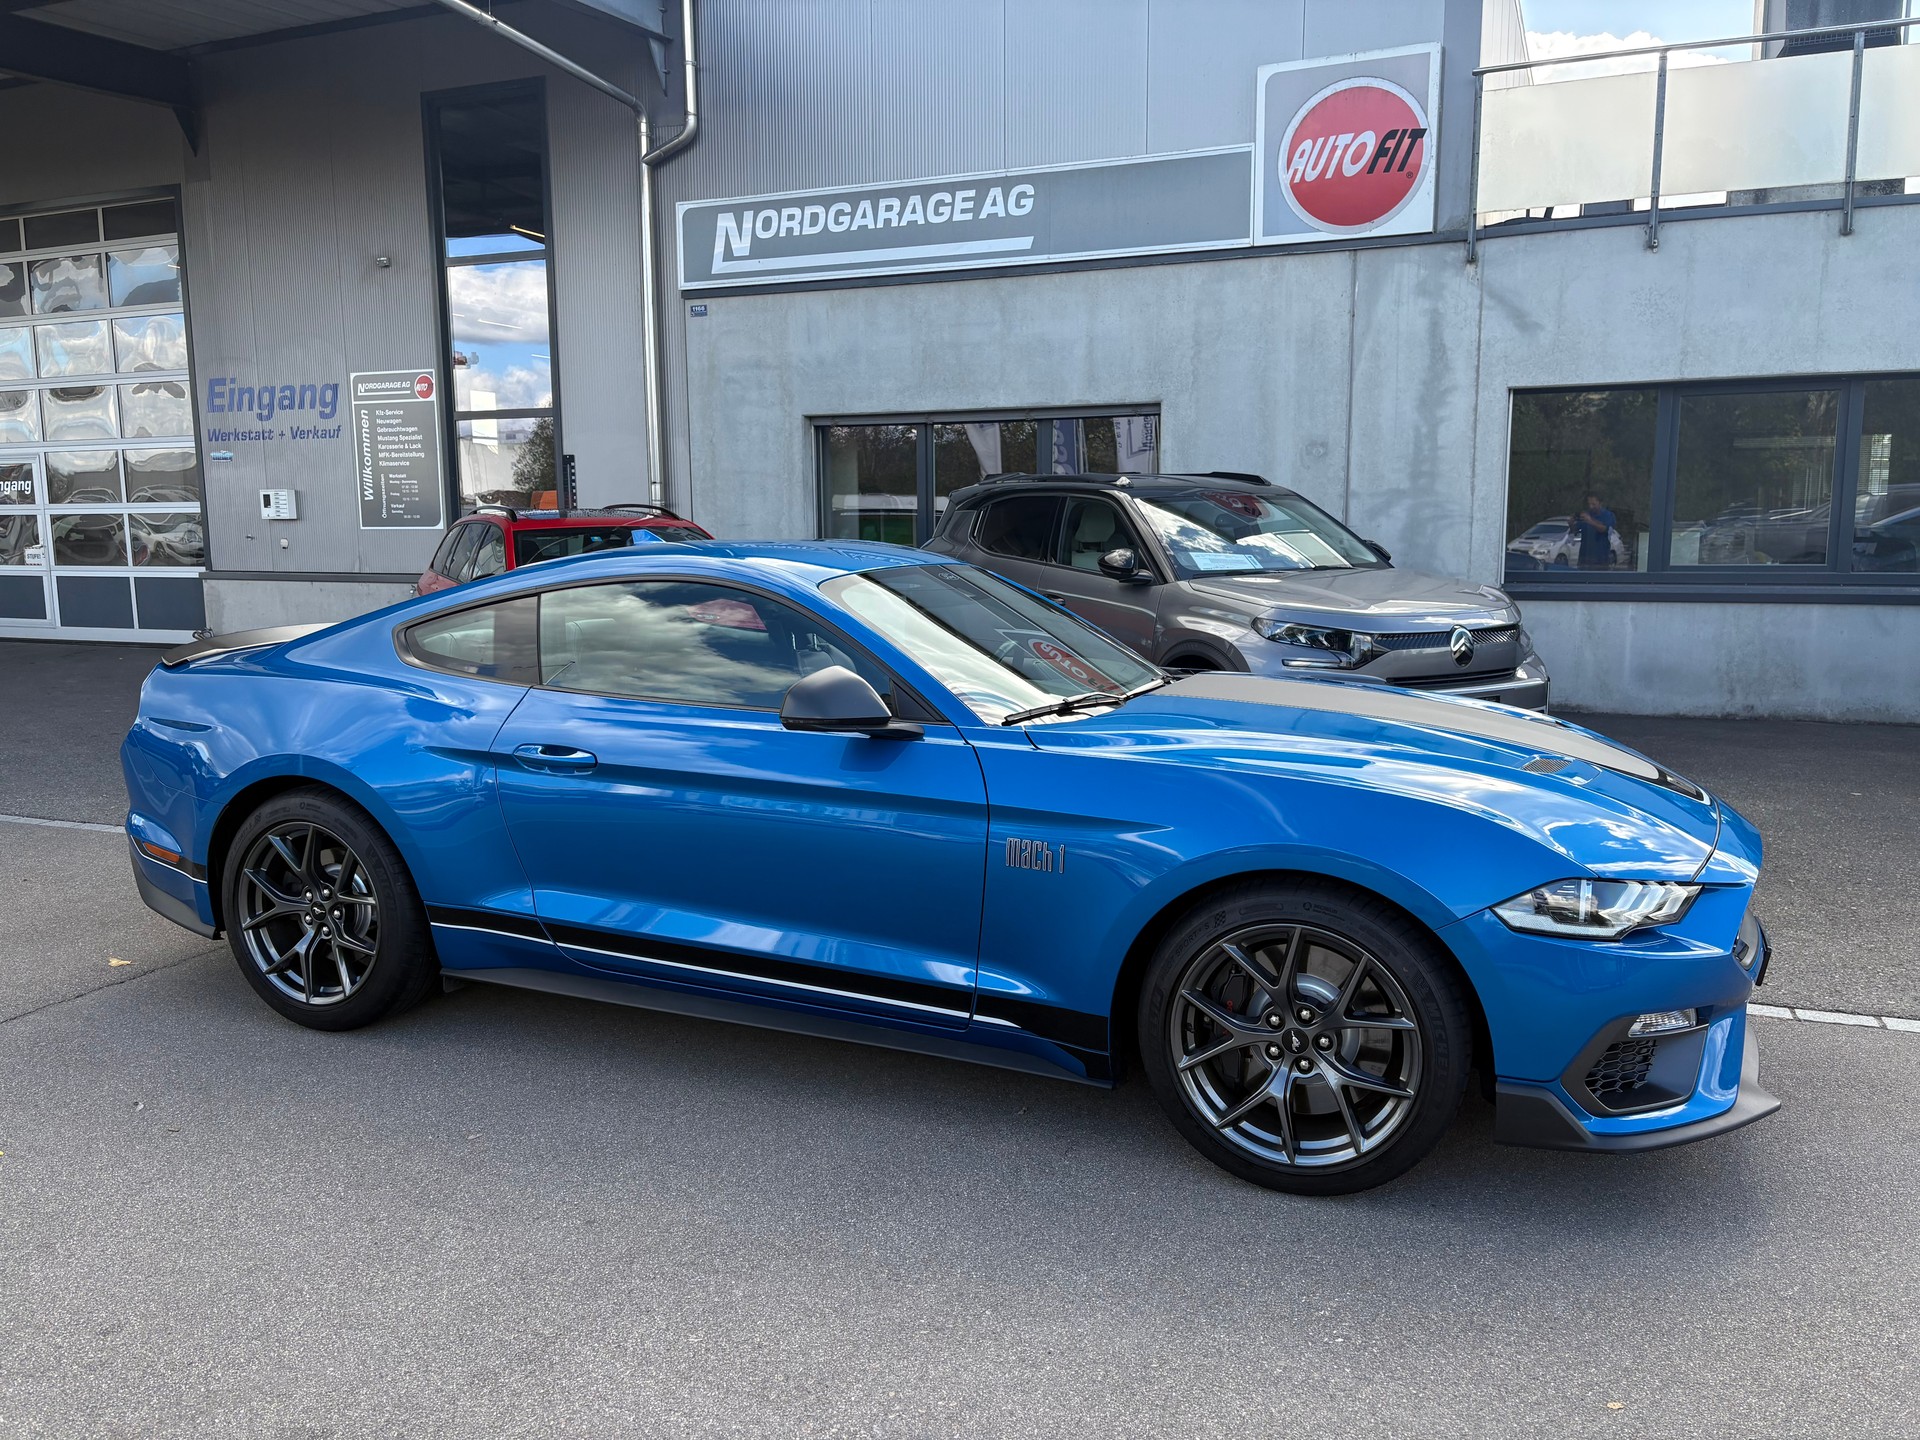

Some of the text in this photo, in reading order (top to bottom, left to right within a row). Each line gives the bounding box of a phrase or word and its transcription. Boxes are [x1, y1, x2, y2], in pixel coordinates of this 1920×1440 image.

[1286, 127, 1428, 185] AUTOFIT
[711, 183, 1036, 270] NORDGARAGE AG
[206, 377, 340, 421] Eingang
[357, 381, 402, 394] NORDGARAGE
[206, 424, 343, 442] Werkstatt + Verkauf
[377, 434, 423, 442] Mustang Spezialist
[360, 408, 375, 501] Willkommen
[1058, 844, 1065, 874] 1
